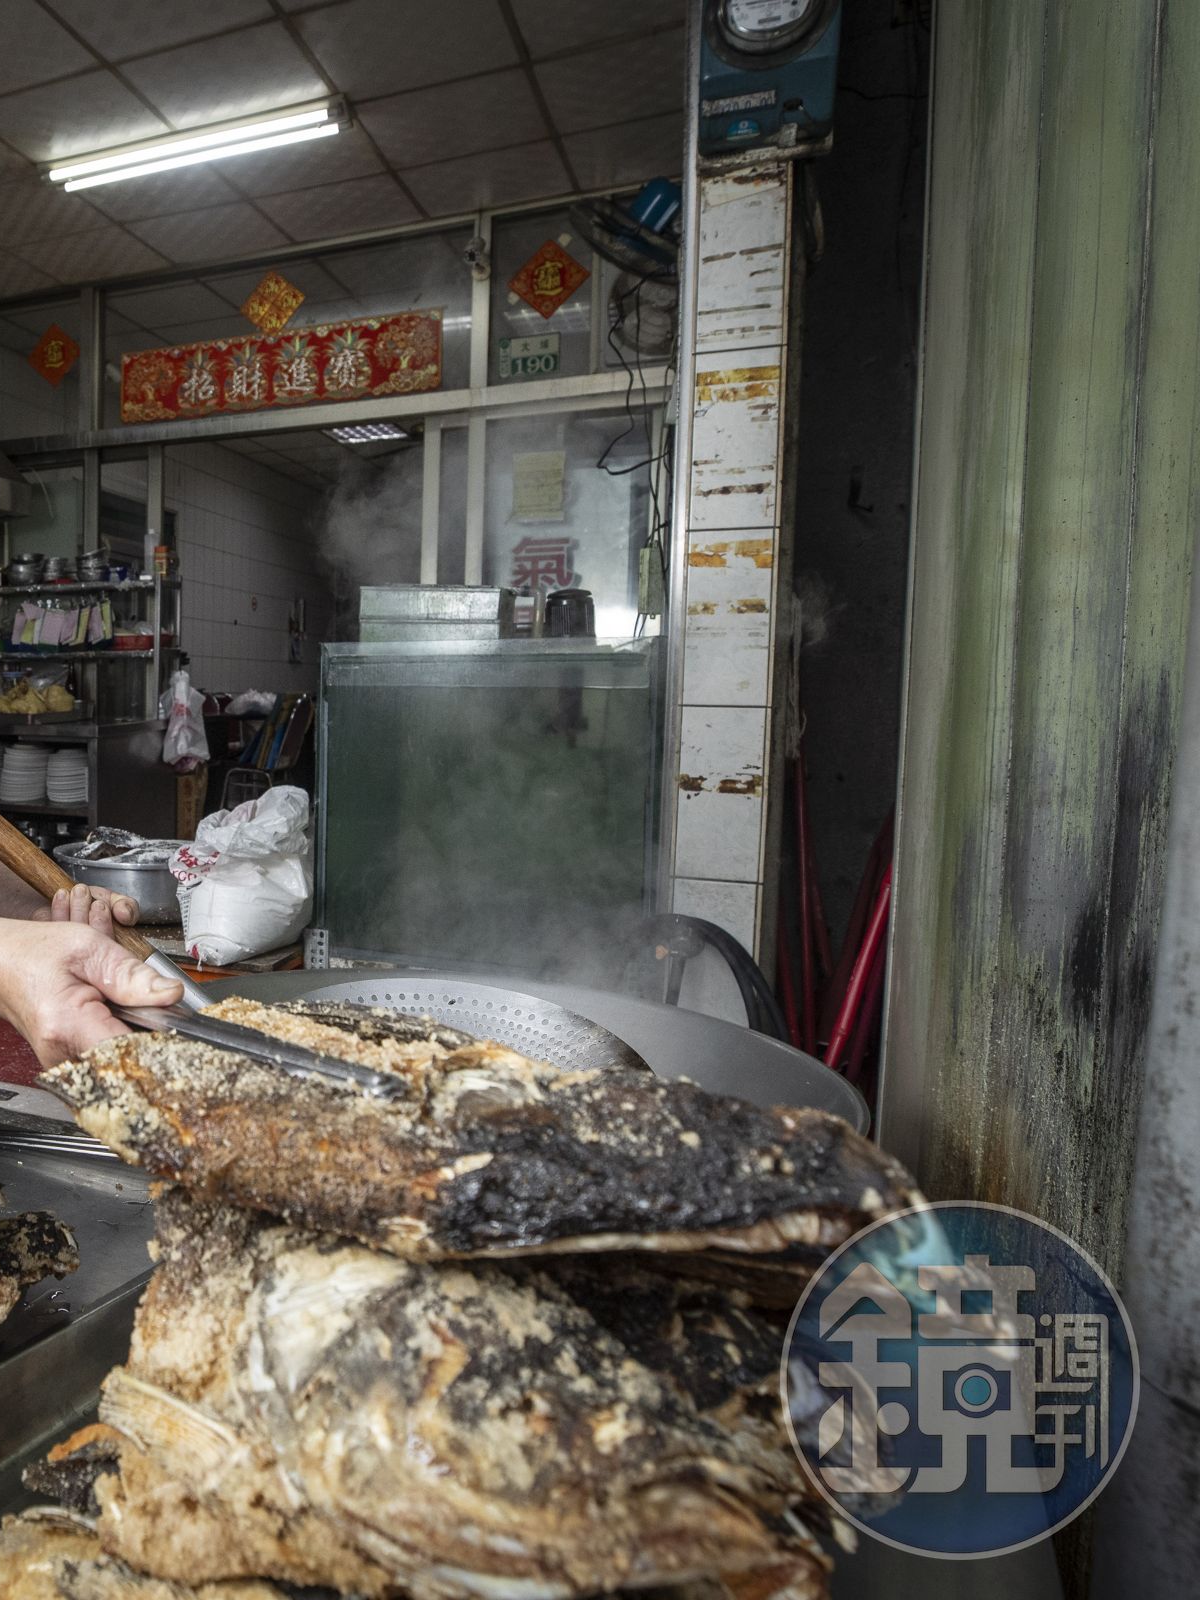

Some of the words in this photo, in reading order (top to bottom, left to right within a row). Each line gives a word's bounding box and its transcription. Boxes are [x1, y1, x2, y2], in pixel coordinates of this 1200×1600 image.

[182, 348, 365, 402] 招財進寶
[514, 355, 555, 376] 190
[511, 537, 574, 624] 氣
